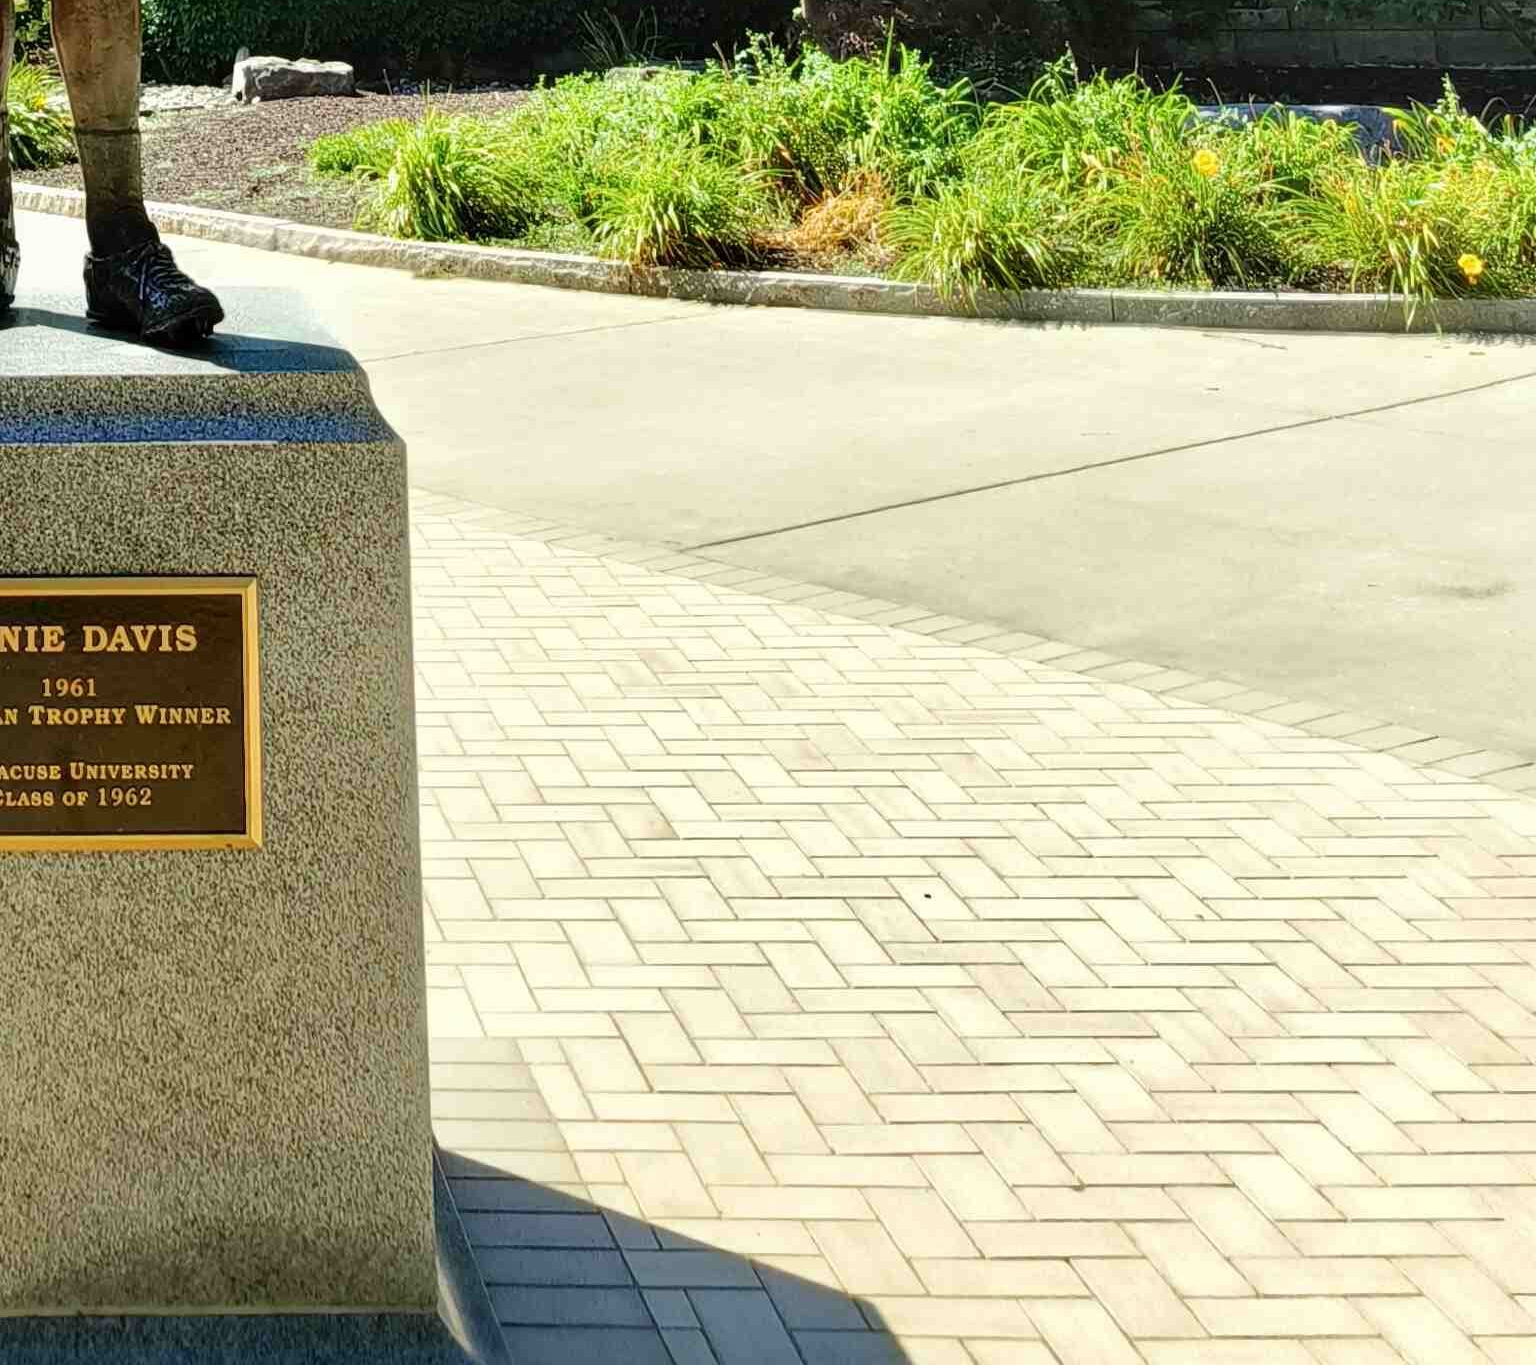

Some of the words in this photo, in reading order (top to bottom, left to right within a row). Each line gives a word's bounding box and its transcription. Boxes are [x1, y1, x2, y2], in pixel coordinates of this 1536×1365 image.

[82, 624, 197, 652] DAVIS
[42, 678, 96, 697] 1961
[28, 705, 126, 726] TROPHY
[134, 704, 231, 725] WINNER
[69, 762, 194, 780] UNIVERSITY
[62, 791, 89, 807] OF
[99, 787, 152, 806] 1962
